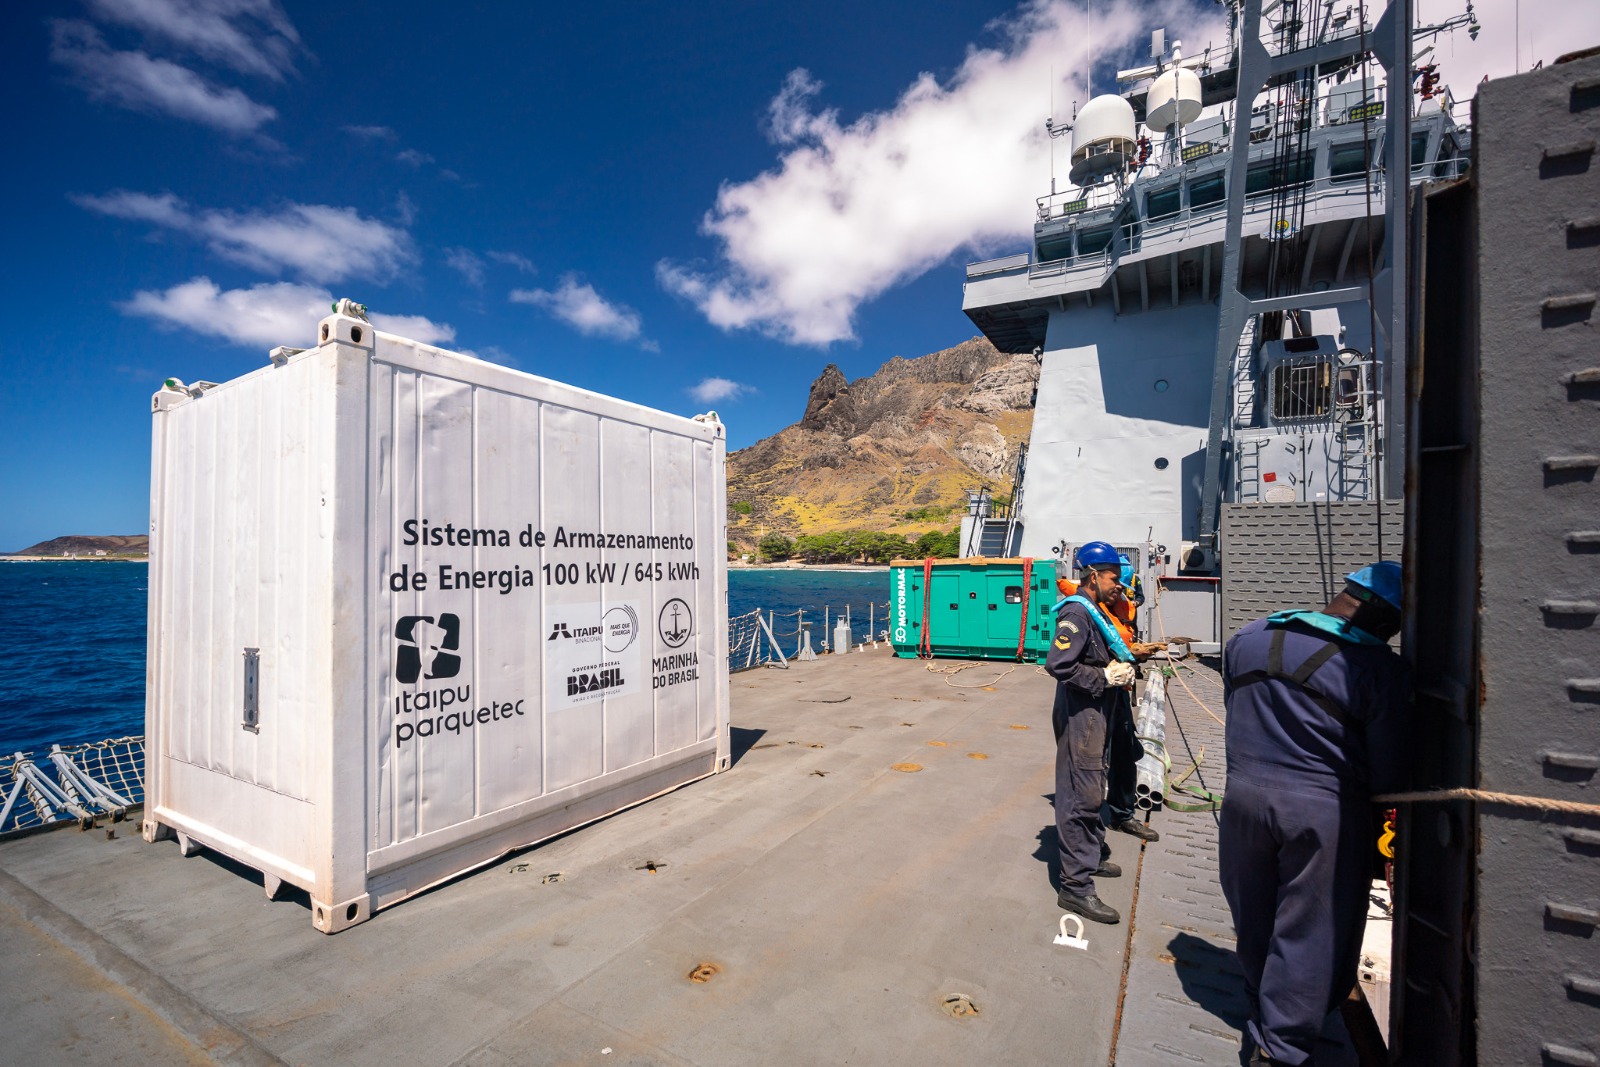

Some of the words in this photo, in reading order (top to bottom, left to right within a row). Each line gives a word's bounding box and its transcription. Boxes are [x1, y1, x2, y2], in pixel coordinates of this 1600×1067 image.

[403, 519, 510, 547] Sistema
[519, 524, 546, 547] de
[553, 526, 694, 550] Armazenamento
[389, 564, 427, 592] de
[439, 564, 534, 595] Energia
[542, 563, 579, 586] 100
[586, 562, 616, 584] kW
[621, 563, 629, 585] /
[635, 562, 663, 582] 645
[668, 562, 700, 581] kWh
[898, 568, 906, 627] MOTORMAC
[573, 626, 604, 638] ITAIPU
[572, 664, 598, 673] GOVERNO
[653, 651, 699, 674] MARINHA
[567, 668, 625, 697] BRASIL
[653, 675, 666, 689] DO
[668, 668, 700, 686] BRASIL
[395, 685, 470, 715] itaipu
[396, 699, 525, 749] parquetec
